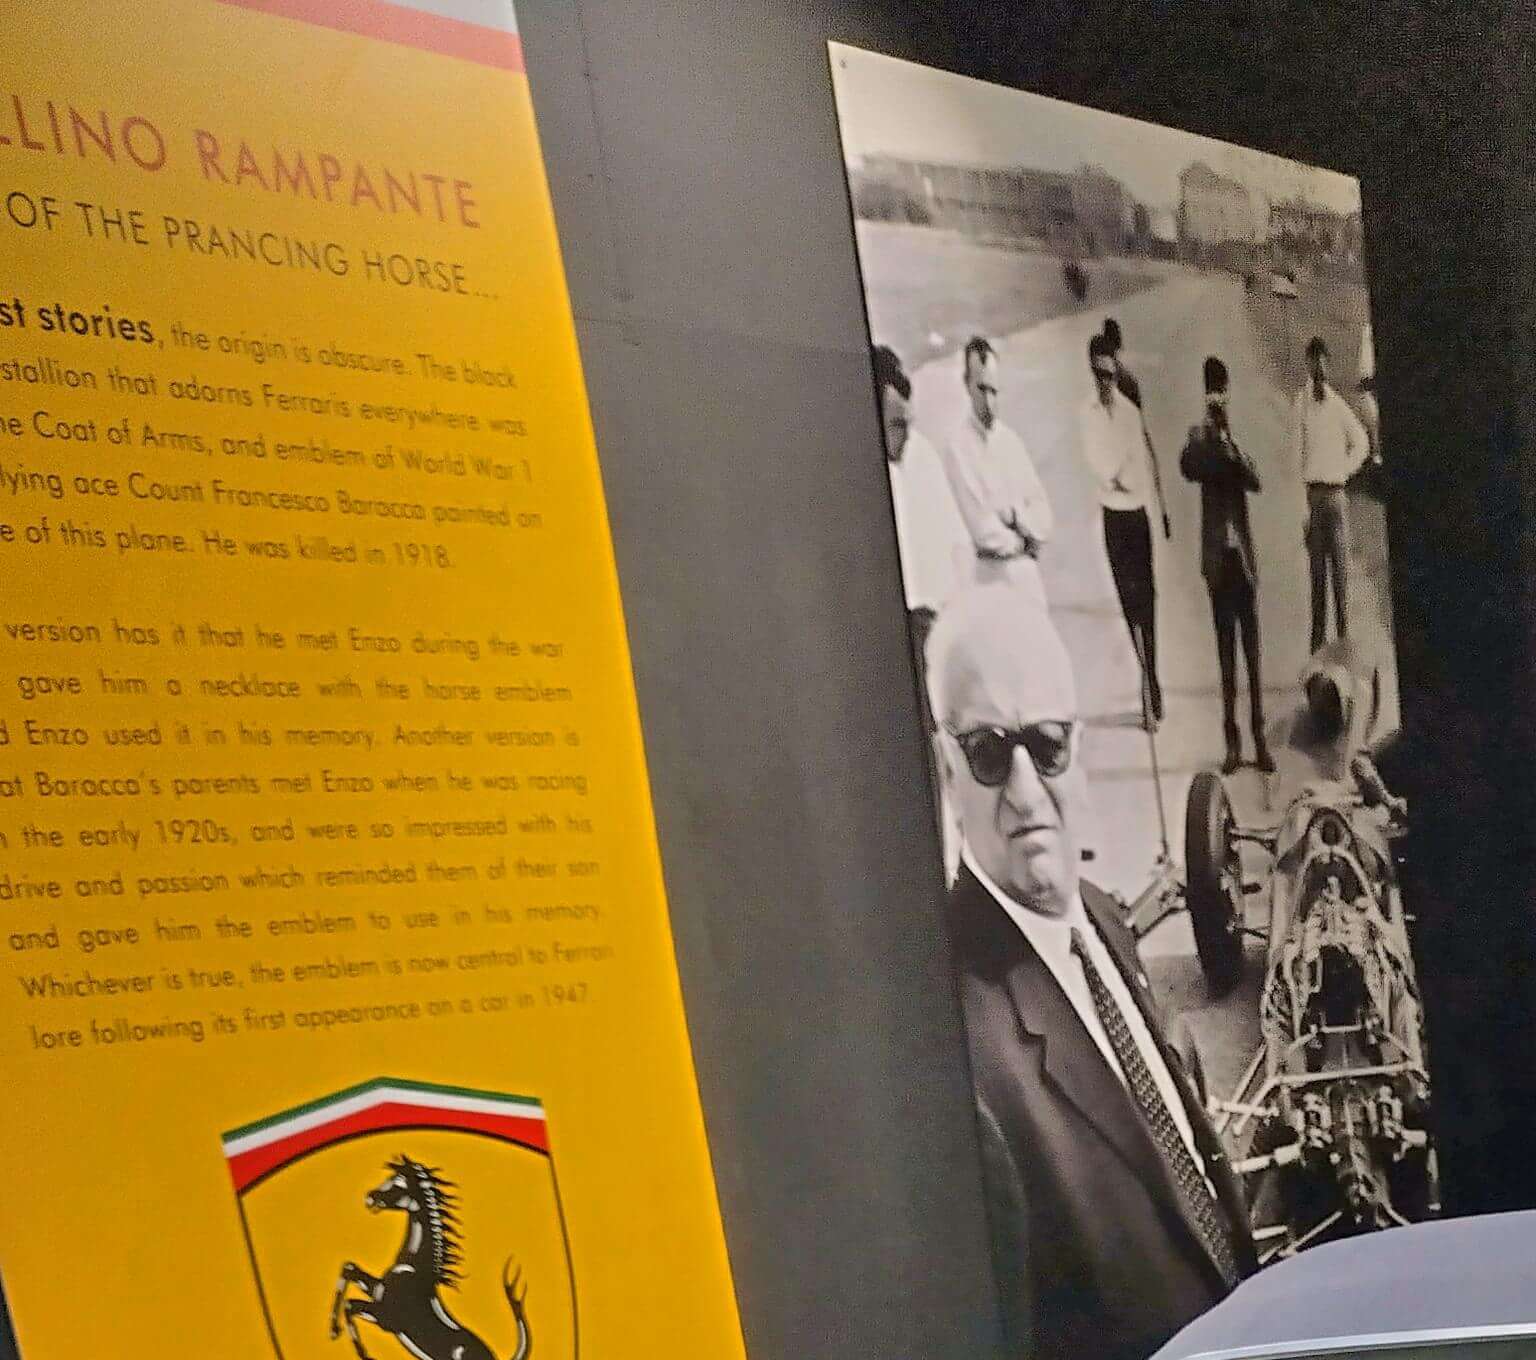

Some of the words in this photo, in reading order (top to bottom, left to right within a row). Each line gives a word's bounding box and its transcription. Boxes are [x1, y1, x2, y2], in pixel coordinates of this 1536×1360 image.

[0, 95, 167, 172] LINO
[194, 128, 481, 229] RAMPANTE
[7, 191, 60, 230] OF
[74, 202, 149, 245] THE
[162, 216, 349, 276] PRANCING
[37, 303, 164, 350] stories,
[171, 322, 209, 350] the
[218, 330, 286, 364] origin
[293, 337, 312, 363] is
[318, 341, 413, 376] obscure.
[415, 353, 457, 381] The
[463, 360, 517, 388] black
[0, 357, 97, 390] stallion
[107, 367, 157, 396] that
[169, 376, 253, 407] adorns
[262, 383, 351, 418] Ferraris
[360, 402, 480, 432] everywhere
[32, 411, 97, 442] Coat
[106, 418, 132, 446] of
[142, 423, 212, 457] Arms,
[220, 433, 267, 458] and
[273, 438, 364, 466] emblem
[374, 444, 395, 470] of
[401, 449, 466, 477] World
[470, 453, 513, 480] War
[73, 474, 119, 497] ace
[128, 471, 204, 501] Count
[212, 479, 330, 513] Francesco
[432, 501, 511, 527] painted
[25, 516, 51, 545] of
[59, 517, 107, 549] this
[115, 523, 195, 556] plane.
[200, 528, 238, 556] He
[245, 539, 289, 560] was
[293, 534, 358, 563] killed
[6, 616, 100, 644] version
[111, 618, 160, 645] has
[172, 621, 185, 645] it
[199, 621, 244, 647] that
[255, 622, 286, 649] he
[296, 630, 338, 650] met
[349, 626, 400, 651] Enzo
[411, 630, 480, 661] during
[487, 630, 520, 656] the
[530, 641, 564, 657] war
[17, 676, 81, 700] gave
[99, 668, 148, 695] him
[166, 678, 182, 696] a
[201, 671, 300, 697] necklace
[318, 674, 362, 698] with
[376, 677, 409, 699] the
[422, 678, 481, 701] horse
[495, 681, 572, 701] emblem
[23, 719, 89, 745] Enzo
[103, 721, 162, 745] used
[176, 721, 191, 745] it
[206, 721, 227, 745] in
[238, 721, 272, 746] his
[393, 722, 473, 746] Another
[487, 727, 554, 746] version
[34, 770, 161, 797] Baracca's
[173, 774, 261, 800] parents
[271, 772, 311, 793] met
[321, 769, 374, 793] Enzo
[382, 771, 438, 792] when
[448, 771, 473, 791] he
[482, 776, 519, 791] was
[528, 773, 587, 796] racing
[22, 825, 64, 848] the
[79, 821, 140, 850] early
[154, 819, 238, 846] 1920s,
[251, 817, 296, 842] and
[307, 821, 359, 839] were
[370, 823, 393, 839] so
[405, 816, 507, 840] impressed
[517, 814, 556, 832] with
[565, 813, 592, 833] his
[0, 874, 62, 900] drive
[74, 870, 124, 897] and
[137, 868, 229, 899] passion
[239, 864, 304, 889] which
[317, 864, 417, 887] reminded
[425, 860, 478, 881] them
[487, 857, 506, 880] of
[515, 858, 557, 878] their
[566, 861, 600, 877] son
[9, 924, 60, 951] and
[77, 926, 140, 953] gave
[153, 917, 201, 941] him
[214, 914, 253, 938] the
[267, 910, 356, 936] emblem
[368, 911, 391, 930] to
[404, 912, 439, 928] use
[453, 906, 472, 926] in
[484, 904, 513, 924] his
[18, 970, 154, 998] Whichever
[161, 966, 182, 990] is
[250, 961, 285, 984] the
[293, 955, 380, 981] emblem
[384, 954, 402, 975] is
[408, 956, 449, 973] now
[457, 947, 523, 970] central
[528, 946, 548, 964] to
[30, 1024, 82, 1049] lore
[90, 1017, 205, 1044] following
[213, 1012, 237, 1034] its
[243, 1006, 285, 1031] first
[294, 1001, 421, 1032] appearance
[427, 1000, 453, 1017] on
[480, 996, 508, 1012] car
[517, 992, 534, 1008] in
